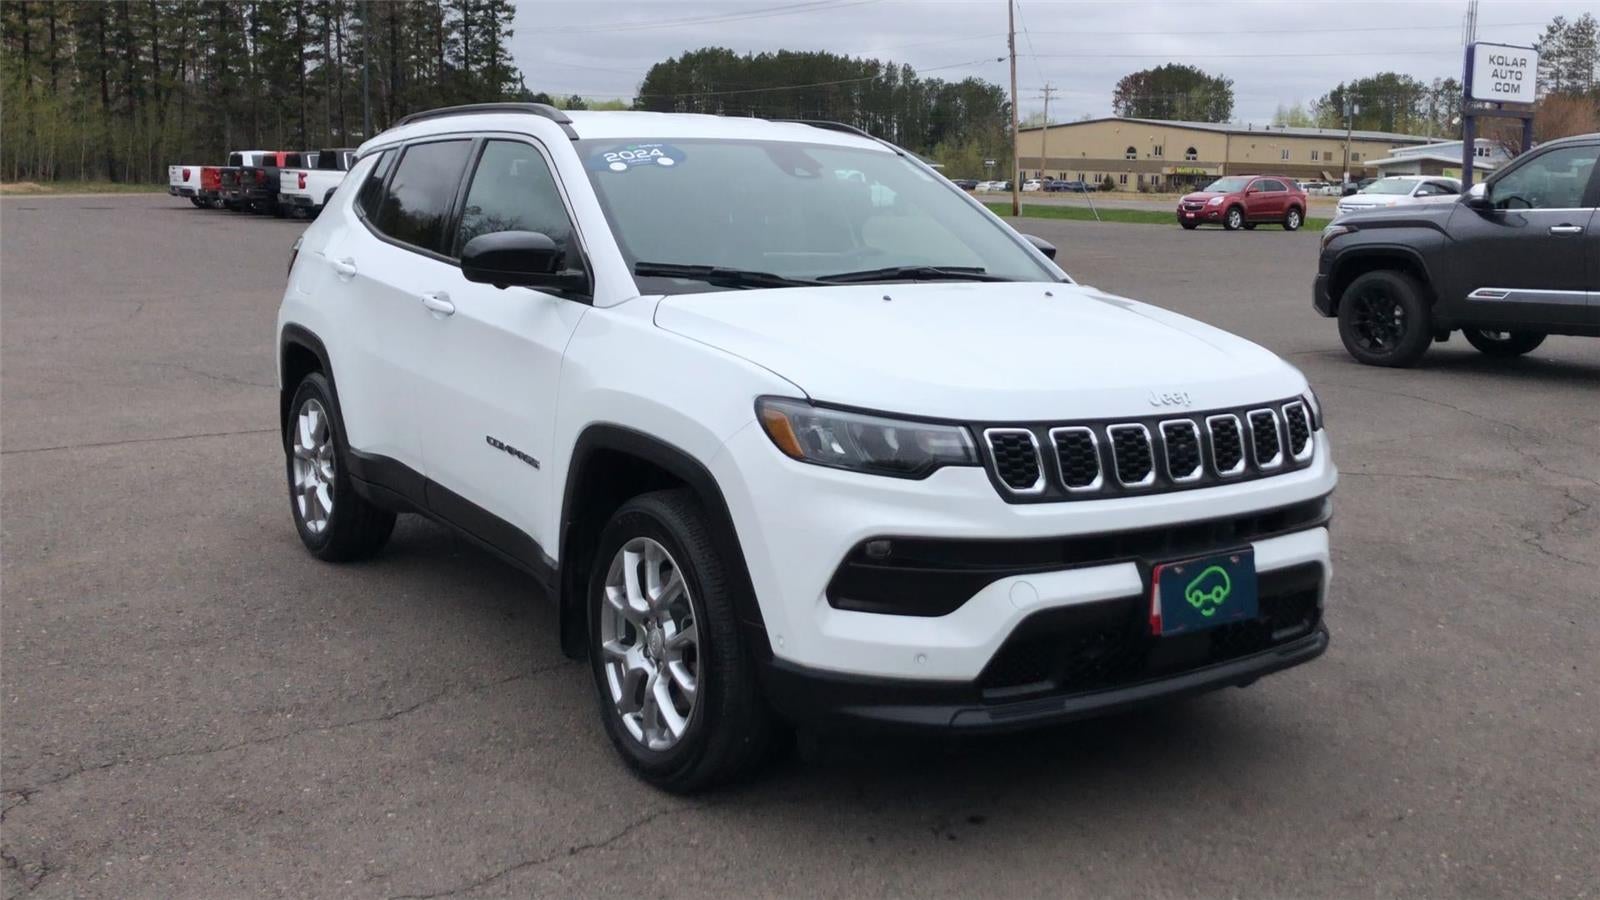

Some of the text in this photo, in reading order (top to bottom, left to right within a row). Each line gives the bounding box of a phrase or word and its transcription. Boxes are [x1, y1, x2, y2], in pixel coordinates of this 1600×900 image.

[1488, 54, 1527, 68] KOLAR
[1491, 68, 1523, 81] AUTO
[1491, 82, 1520, 94] .COM
[603, 148, 665, 163] 2024
[1148, 390, 1192, 409] Jeep
